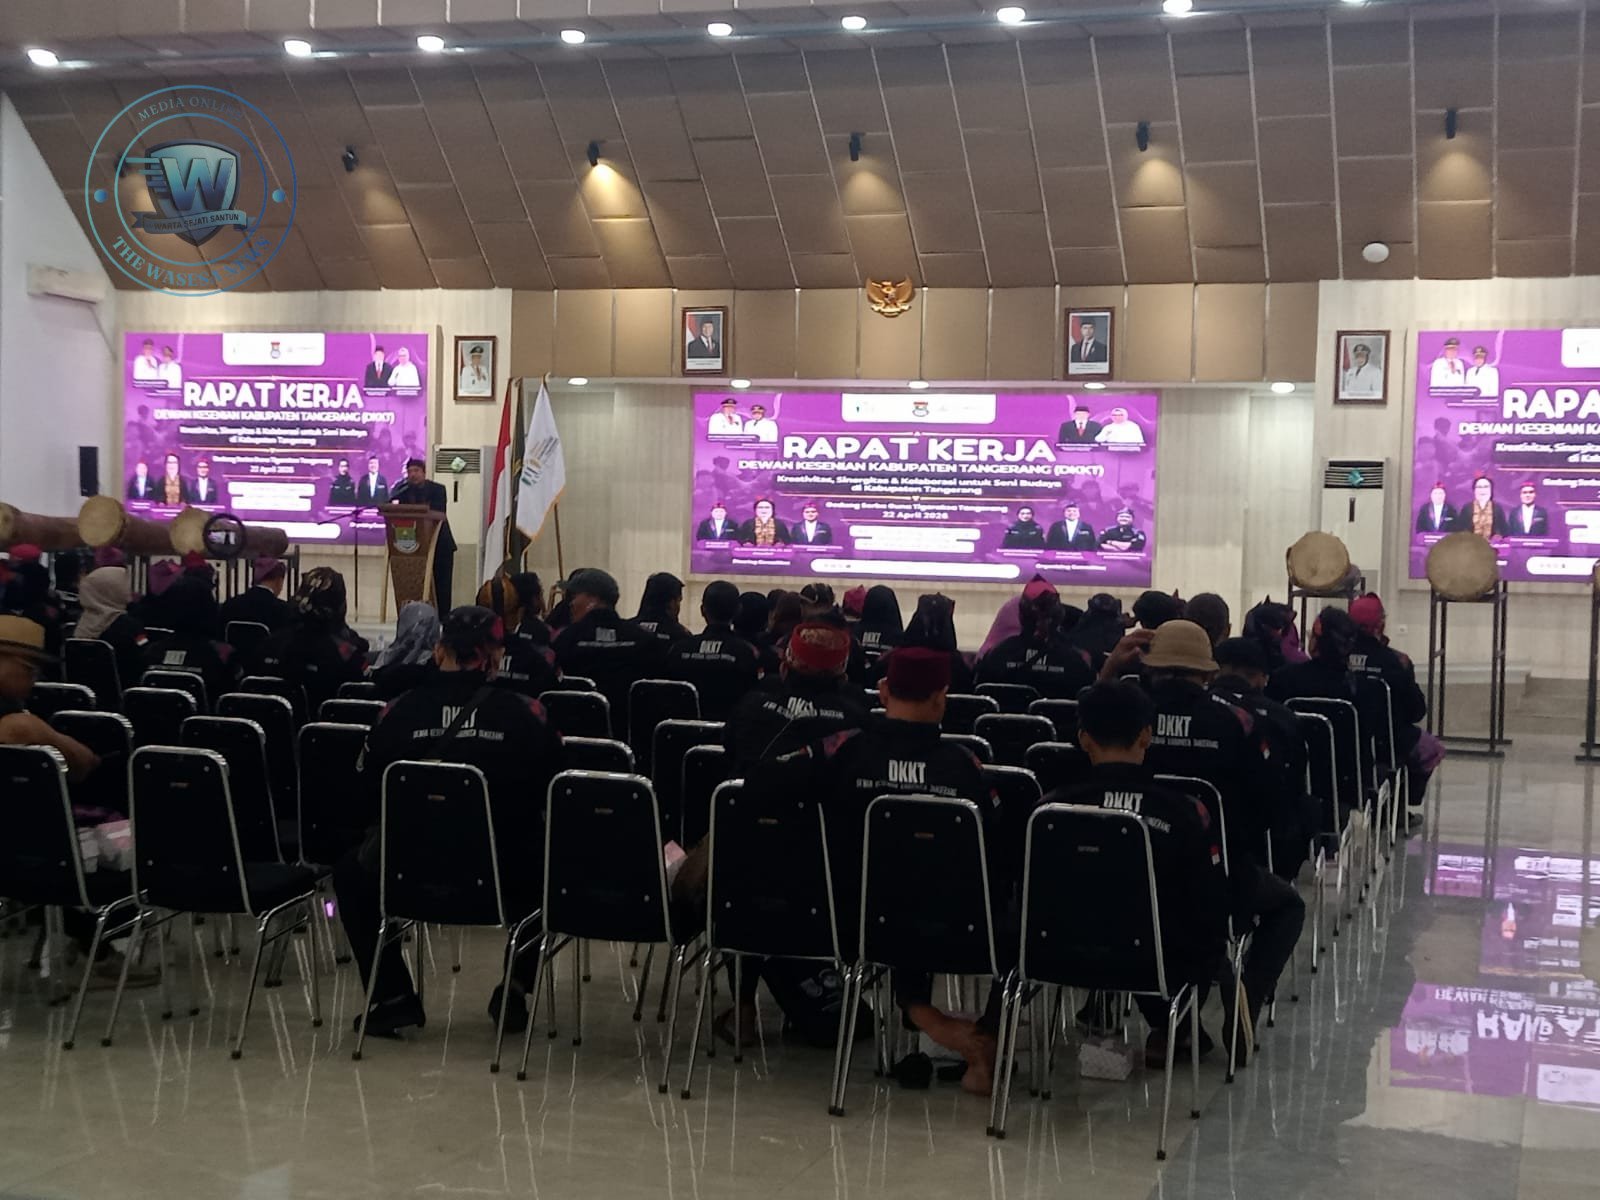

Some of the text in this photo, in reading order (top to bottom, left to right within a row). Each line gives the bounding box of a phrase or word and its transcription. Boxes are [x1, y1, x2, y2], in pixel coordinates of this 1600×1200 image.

[184, 382, 275, 407] RAPAT
[280, 382, 364, 408] KERJA
[1459, 422, 1513, 434] DEWAN
[1515, 423, 1584, 435] KESENIAN
[784, 436, 919, 460] RAPAT
[928, 438, 1056, 462] KERJA
[738, 460, 1105, 477] DEWAN KESENIAN KABUPATEN TANGERANG (DKKT)
[851, 484, 982, 496] di Kabupaten Tangerang
[900, 477, 957, 486] Kolaborasi
[958, 478, 992, 487] untuk
[993, 479, 1018, 487] Seni
[1019, 479, 1062, 489] Budaya
[882, 510, 896, 519] 22
[896, 511, 922, 520] April
[1157, 713, 1192, 737] DKKT
[888, 760, 926, 783] DKKT
[1103, 791, 1143, 812] DKKT
